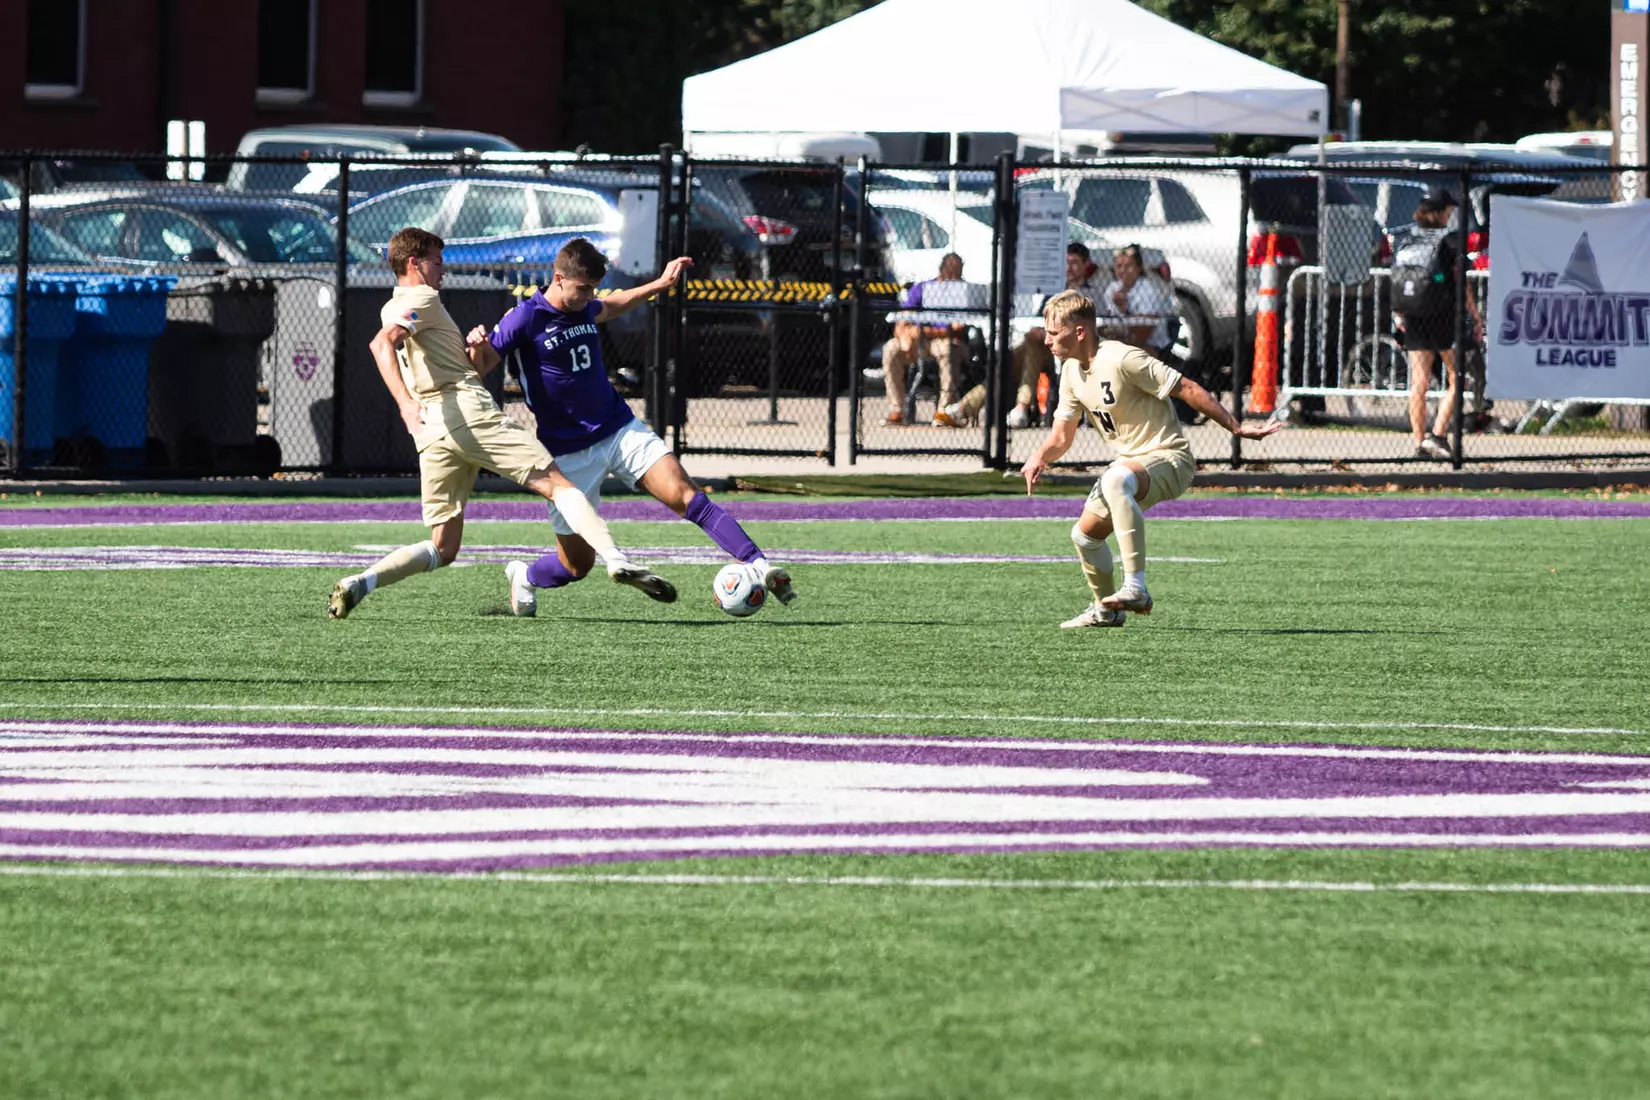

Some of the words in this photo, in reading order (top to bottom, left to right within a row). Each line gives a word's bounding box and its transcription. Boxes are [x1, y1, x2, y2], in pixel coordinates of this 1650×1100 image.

[1620, 43, 1638, 203] EMERGENCY
[1520, 271, 1559, 289] THE
[1499, 291, 1650, 345] SUMMIT
[544, 335, 563, 350] ST.
[569, 344, 592, 372] 13
[1535, 348, 1616, 368] LEAGUE
[1100, 380, 1116, 405] 3
